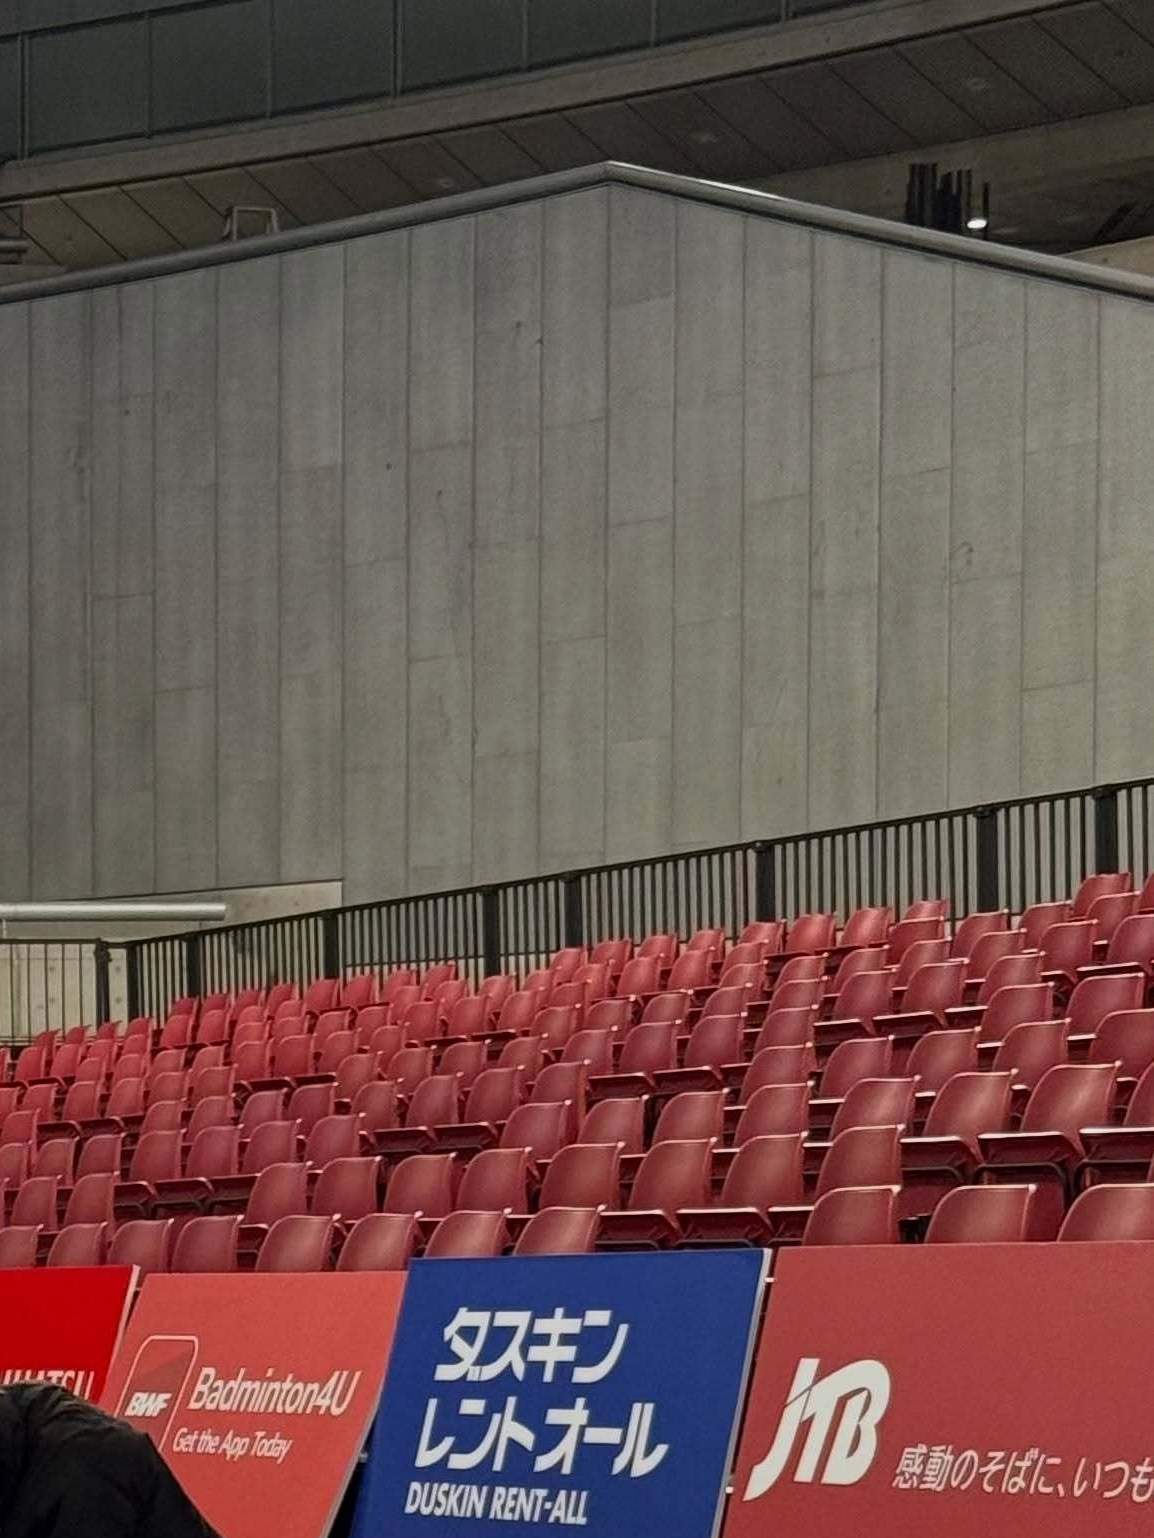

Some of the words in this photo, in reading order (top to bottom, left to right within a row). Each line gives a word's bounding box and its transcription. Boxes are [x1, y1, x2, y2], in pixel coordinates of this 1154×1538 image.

[125, 1392, 173, 1418] BWF
[187, 1366, 363, 1416] Badminton4U
[172, 1427, 198, 1453] Get
[197, 1428, 220, 1455] the
[218, 1429, 250, 1461] App
[250, 1431, 294, 1465] Today
[414, 1396, 670, 1478] レントオール
[742, 1358, 892, 1502] JTB
[892, 1443, 1154, 1503] 感動のそばに、いつも
[404, 1481, 489, 1519] DUSKIN
[489, 1486, 589, 1526] RENT-ALL
